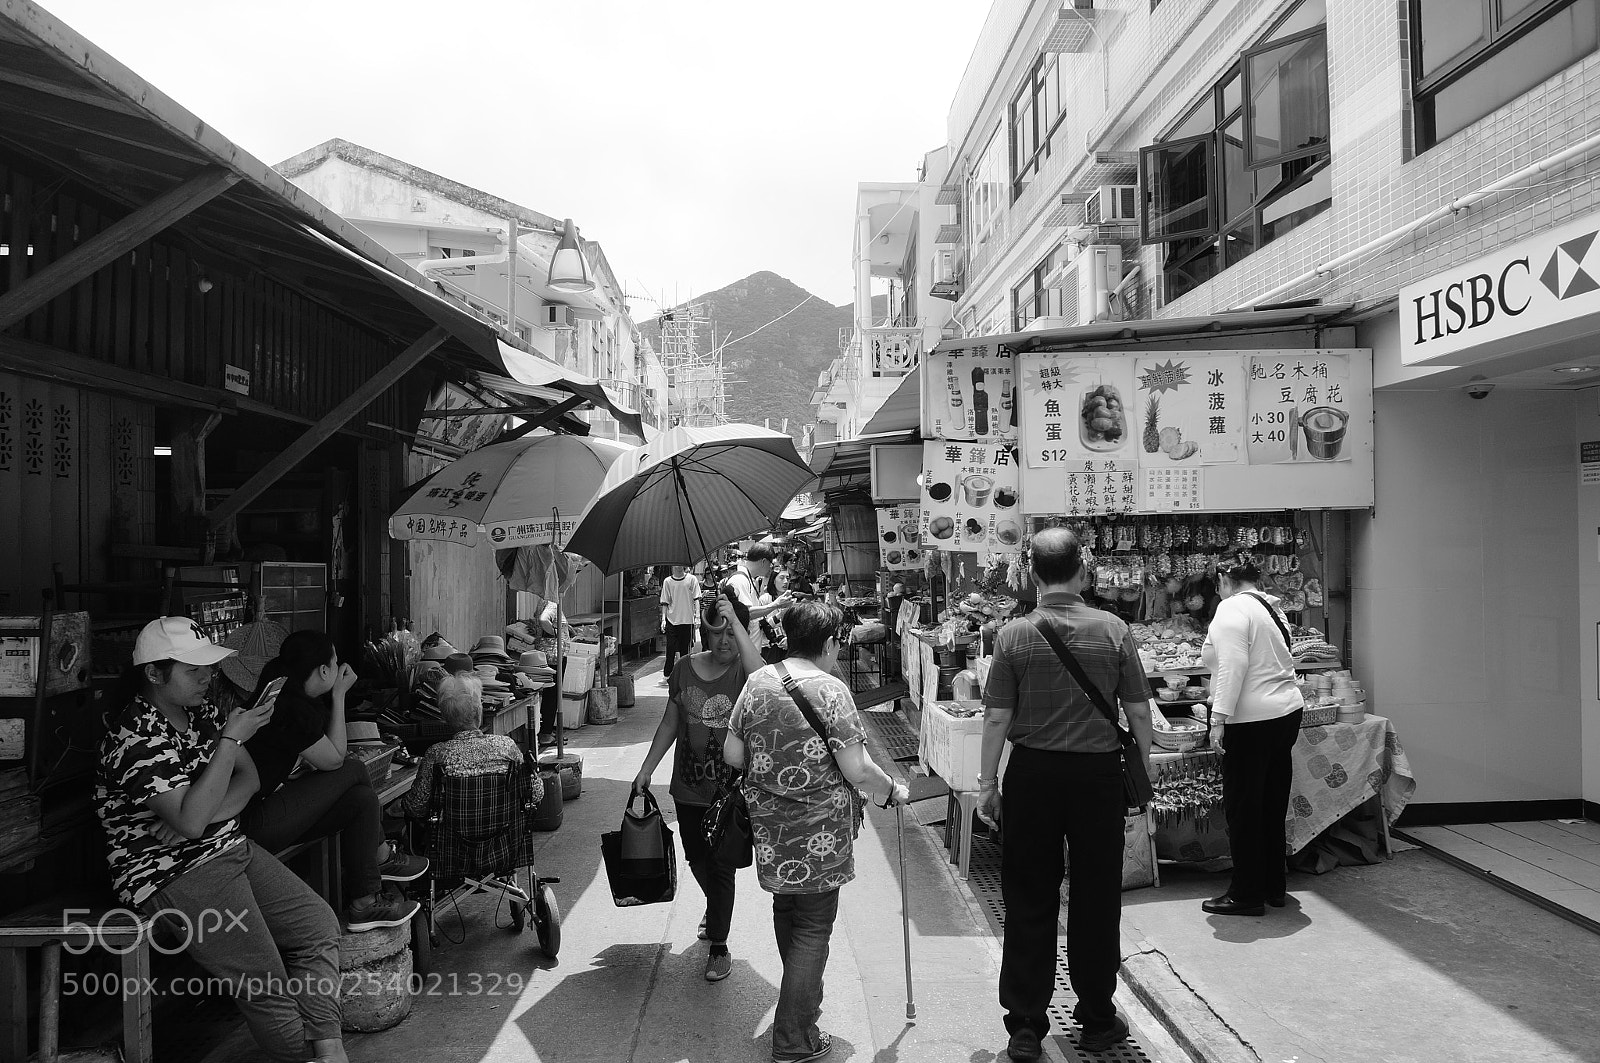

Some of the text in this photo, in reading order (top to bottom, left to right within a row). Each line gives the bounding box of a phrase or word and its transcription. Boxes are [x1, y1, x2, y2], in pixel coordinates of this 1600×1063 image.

[1413, 256, 1532, 345] HSBC
[1039, 366, 1061, 379] 超級
[1041, 379, 1063, 391] 特大
[1278, 383, 1343, 405] 豆腐花
[1207, 368, 1226, 435] 冰菠蘿
[1044, 398, 1062, 441] 魚蛋
[1251, 411, 1285, 426] 小 30
[1251, 429, 1286, 444] 大 40
[1041, 449, 1067, 462] $12
[407, 516, 468, 538] 中国名牌产品
